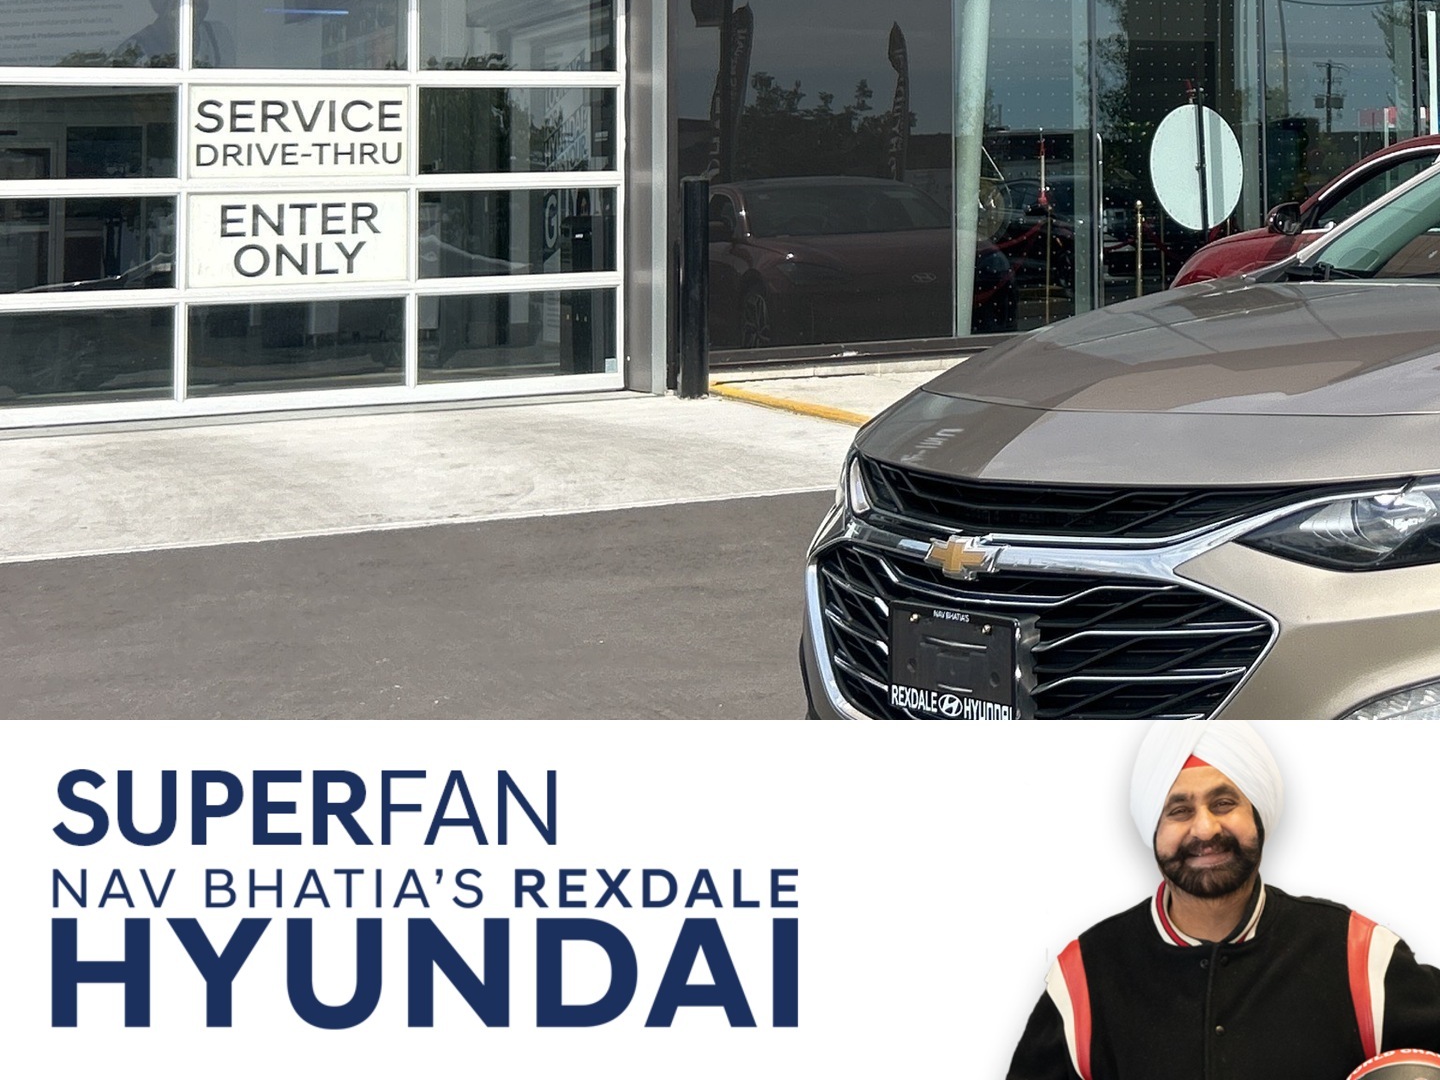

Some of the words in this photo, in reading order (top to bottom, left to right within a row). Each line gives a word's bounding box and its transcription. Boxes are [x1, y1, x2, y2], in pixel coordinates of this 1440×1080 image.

[194, 99, 404, 135] SERVICE
[194, 141, 404, 168] DRIVE-THRU
[219, 201, 381, 238] ENTER
[233, 241, 366, 278] ONLY
[932, 609, 945, 618] NAV
[891, 684, 938, 713] REXDALE
